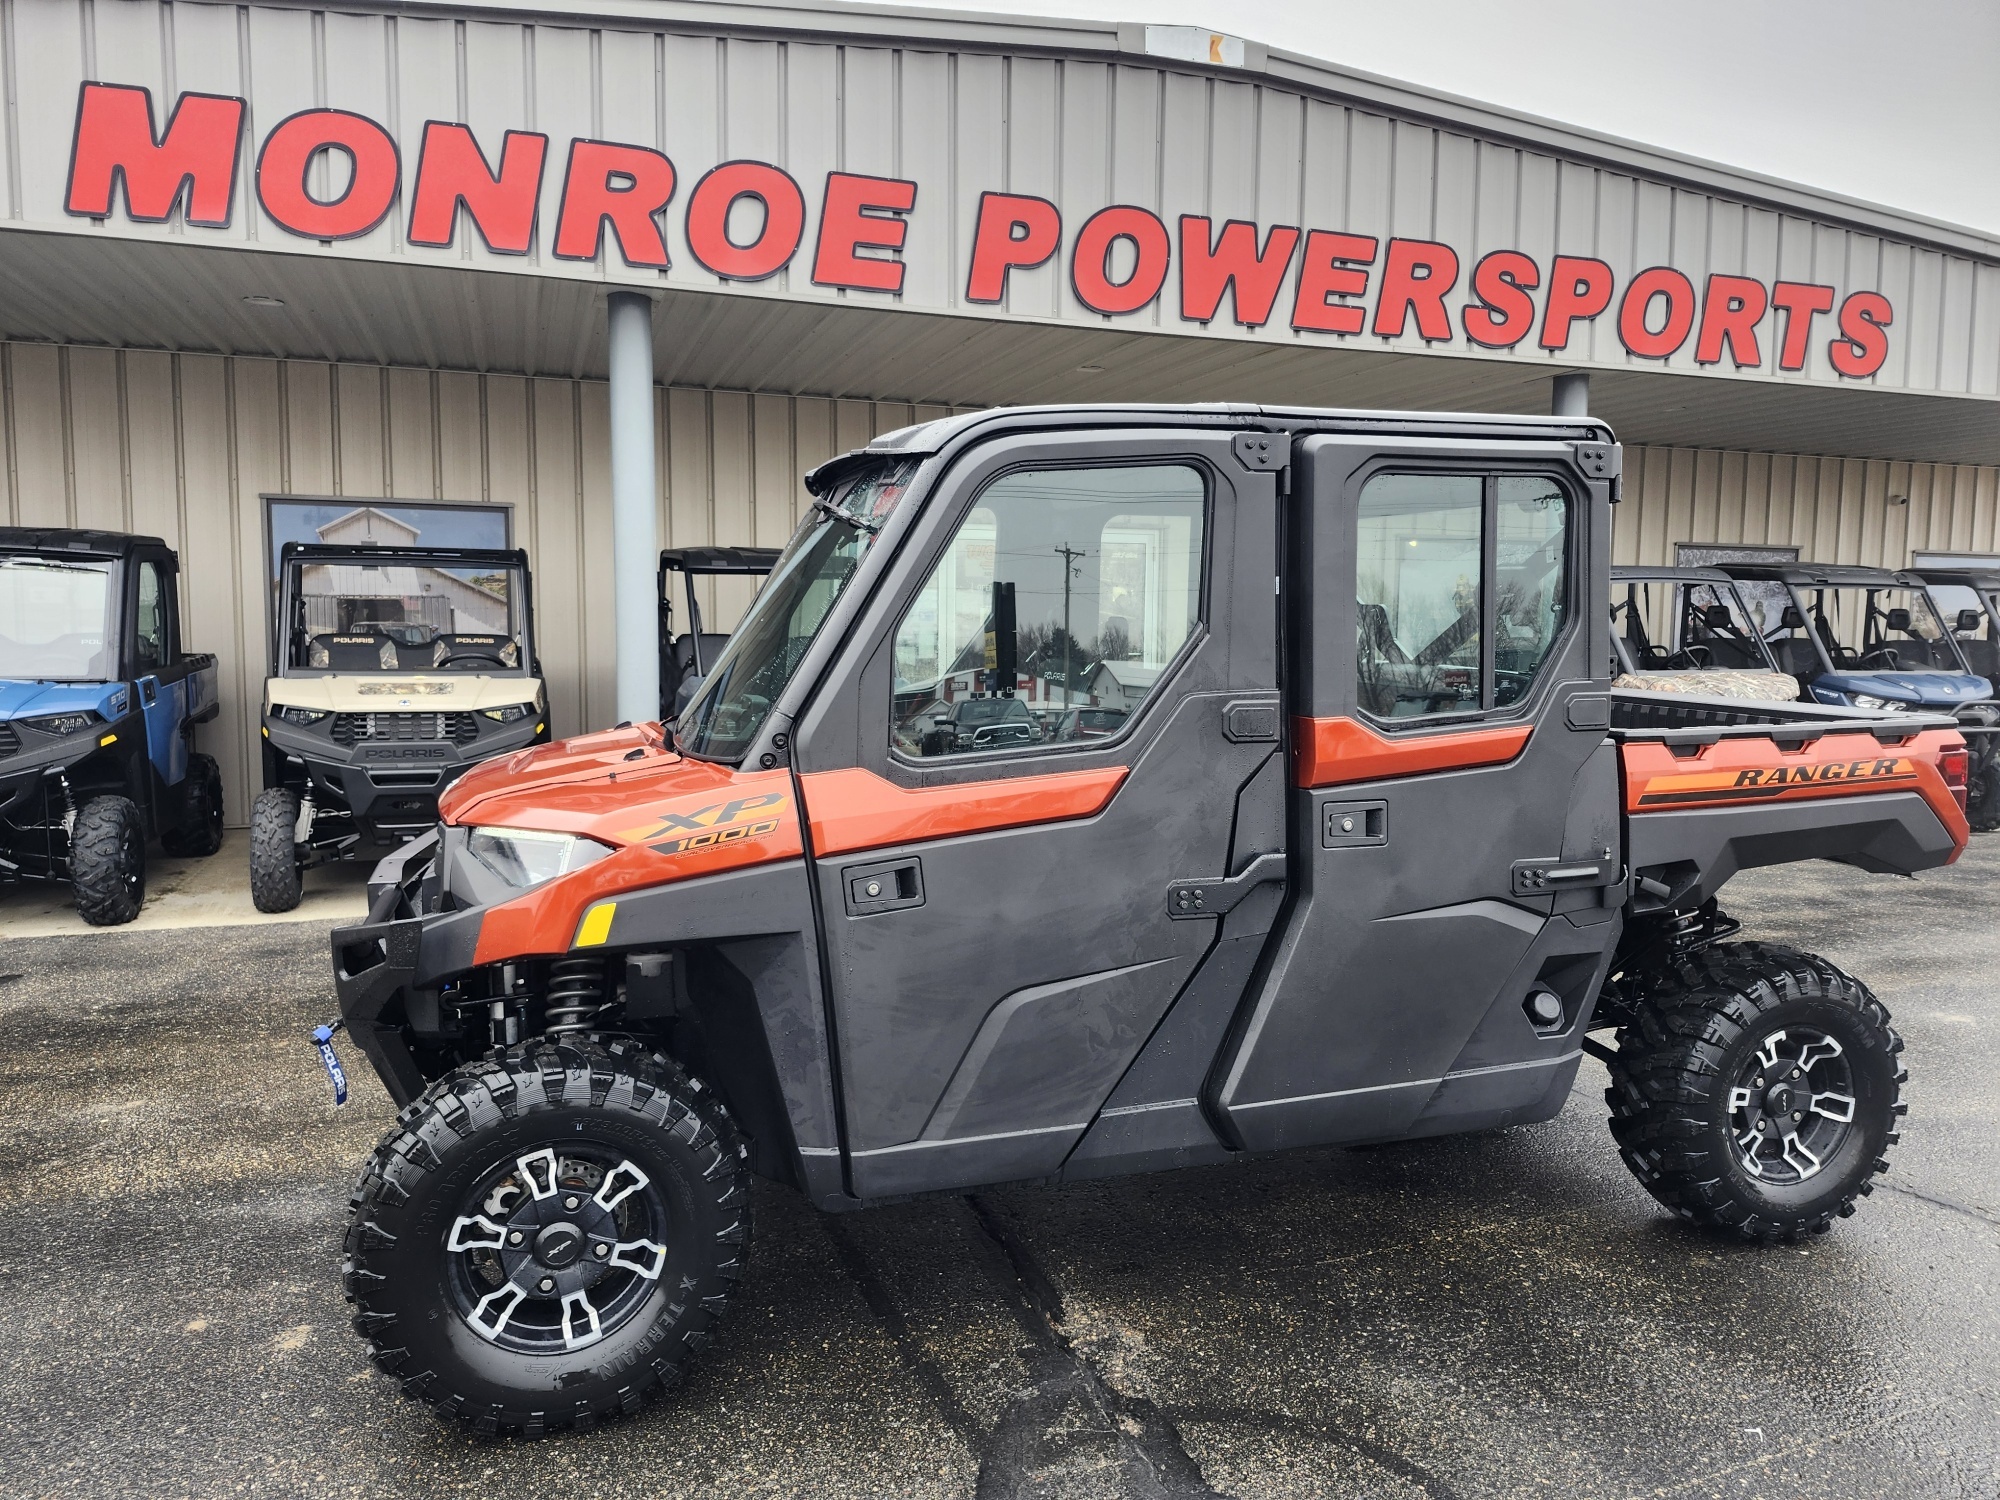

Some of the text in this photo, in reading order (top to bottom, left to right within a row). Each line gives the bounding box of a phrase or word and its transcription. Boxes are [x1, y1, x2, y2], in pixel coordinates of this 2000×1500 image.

[65, 82, 1895, 380] MONROE POWERSPORTS
[333, 636, 375, 645] POLARIS
[455, 636, 495, 645] POLARIS
[110, 689, 126, 705] 570
[365, 748, 446, 761] POLARIS
[1733, 758, 1900, 788] RANGER
[641, 792, 785, 841] XP
[677, 819, 779, 852] 1000
[320, 1043, 346, 1096] POLARIS
[597, 1272, 700, 1382] X-TERRAIN
